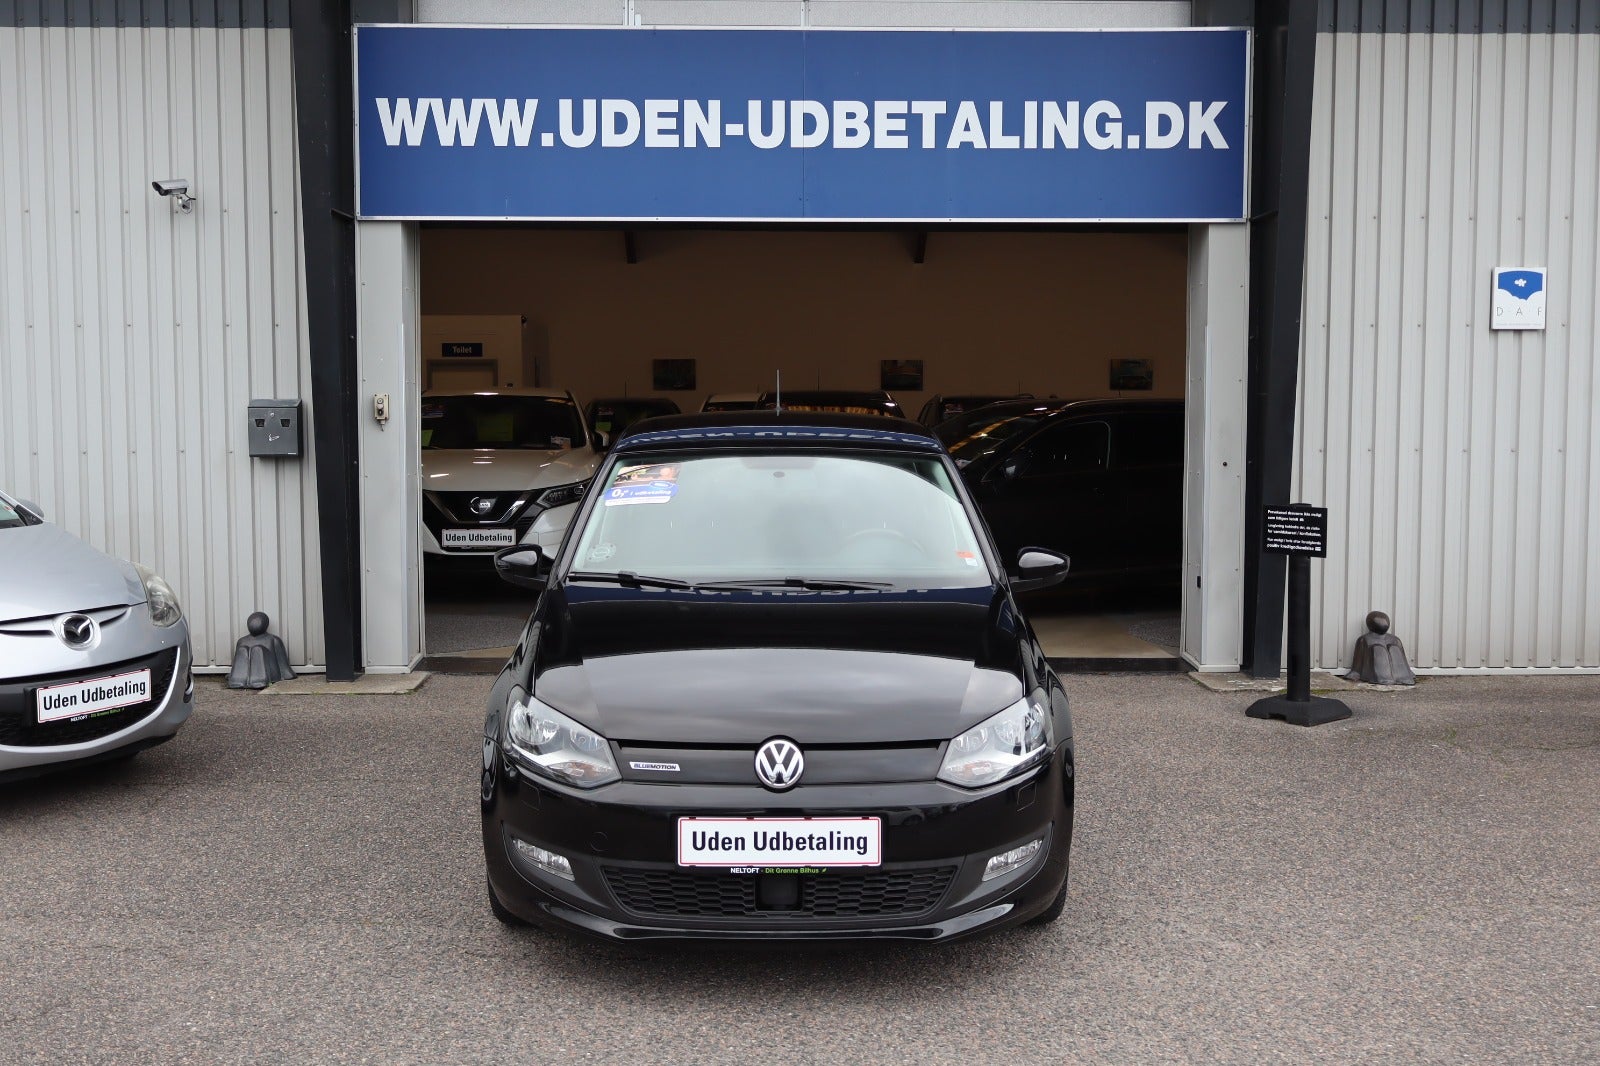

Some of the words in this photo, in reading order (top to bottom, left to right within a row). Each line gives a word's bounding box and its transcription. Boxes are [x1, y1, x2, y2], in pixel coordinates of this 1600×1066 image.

[375, 97, 1230, 150] WWW.UDEN-UDBETALING.DK
[452, 345, 473, 354] Toilet
[445, 533, 467, 542] Uden
[468, 532, 513, 543] Udbetaling
[43, 694, 78, 711] Uden
[81, 680, 146, 704] Udbetaling
[632, 762, 678, 770] BLUEMOTION
[692, 831, 746, 851] Uden
[753, 831, 869, 856] Udbetaling
